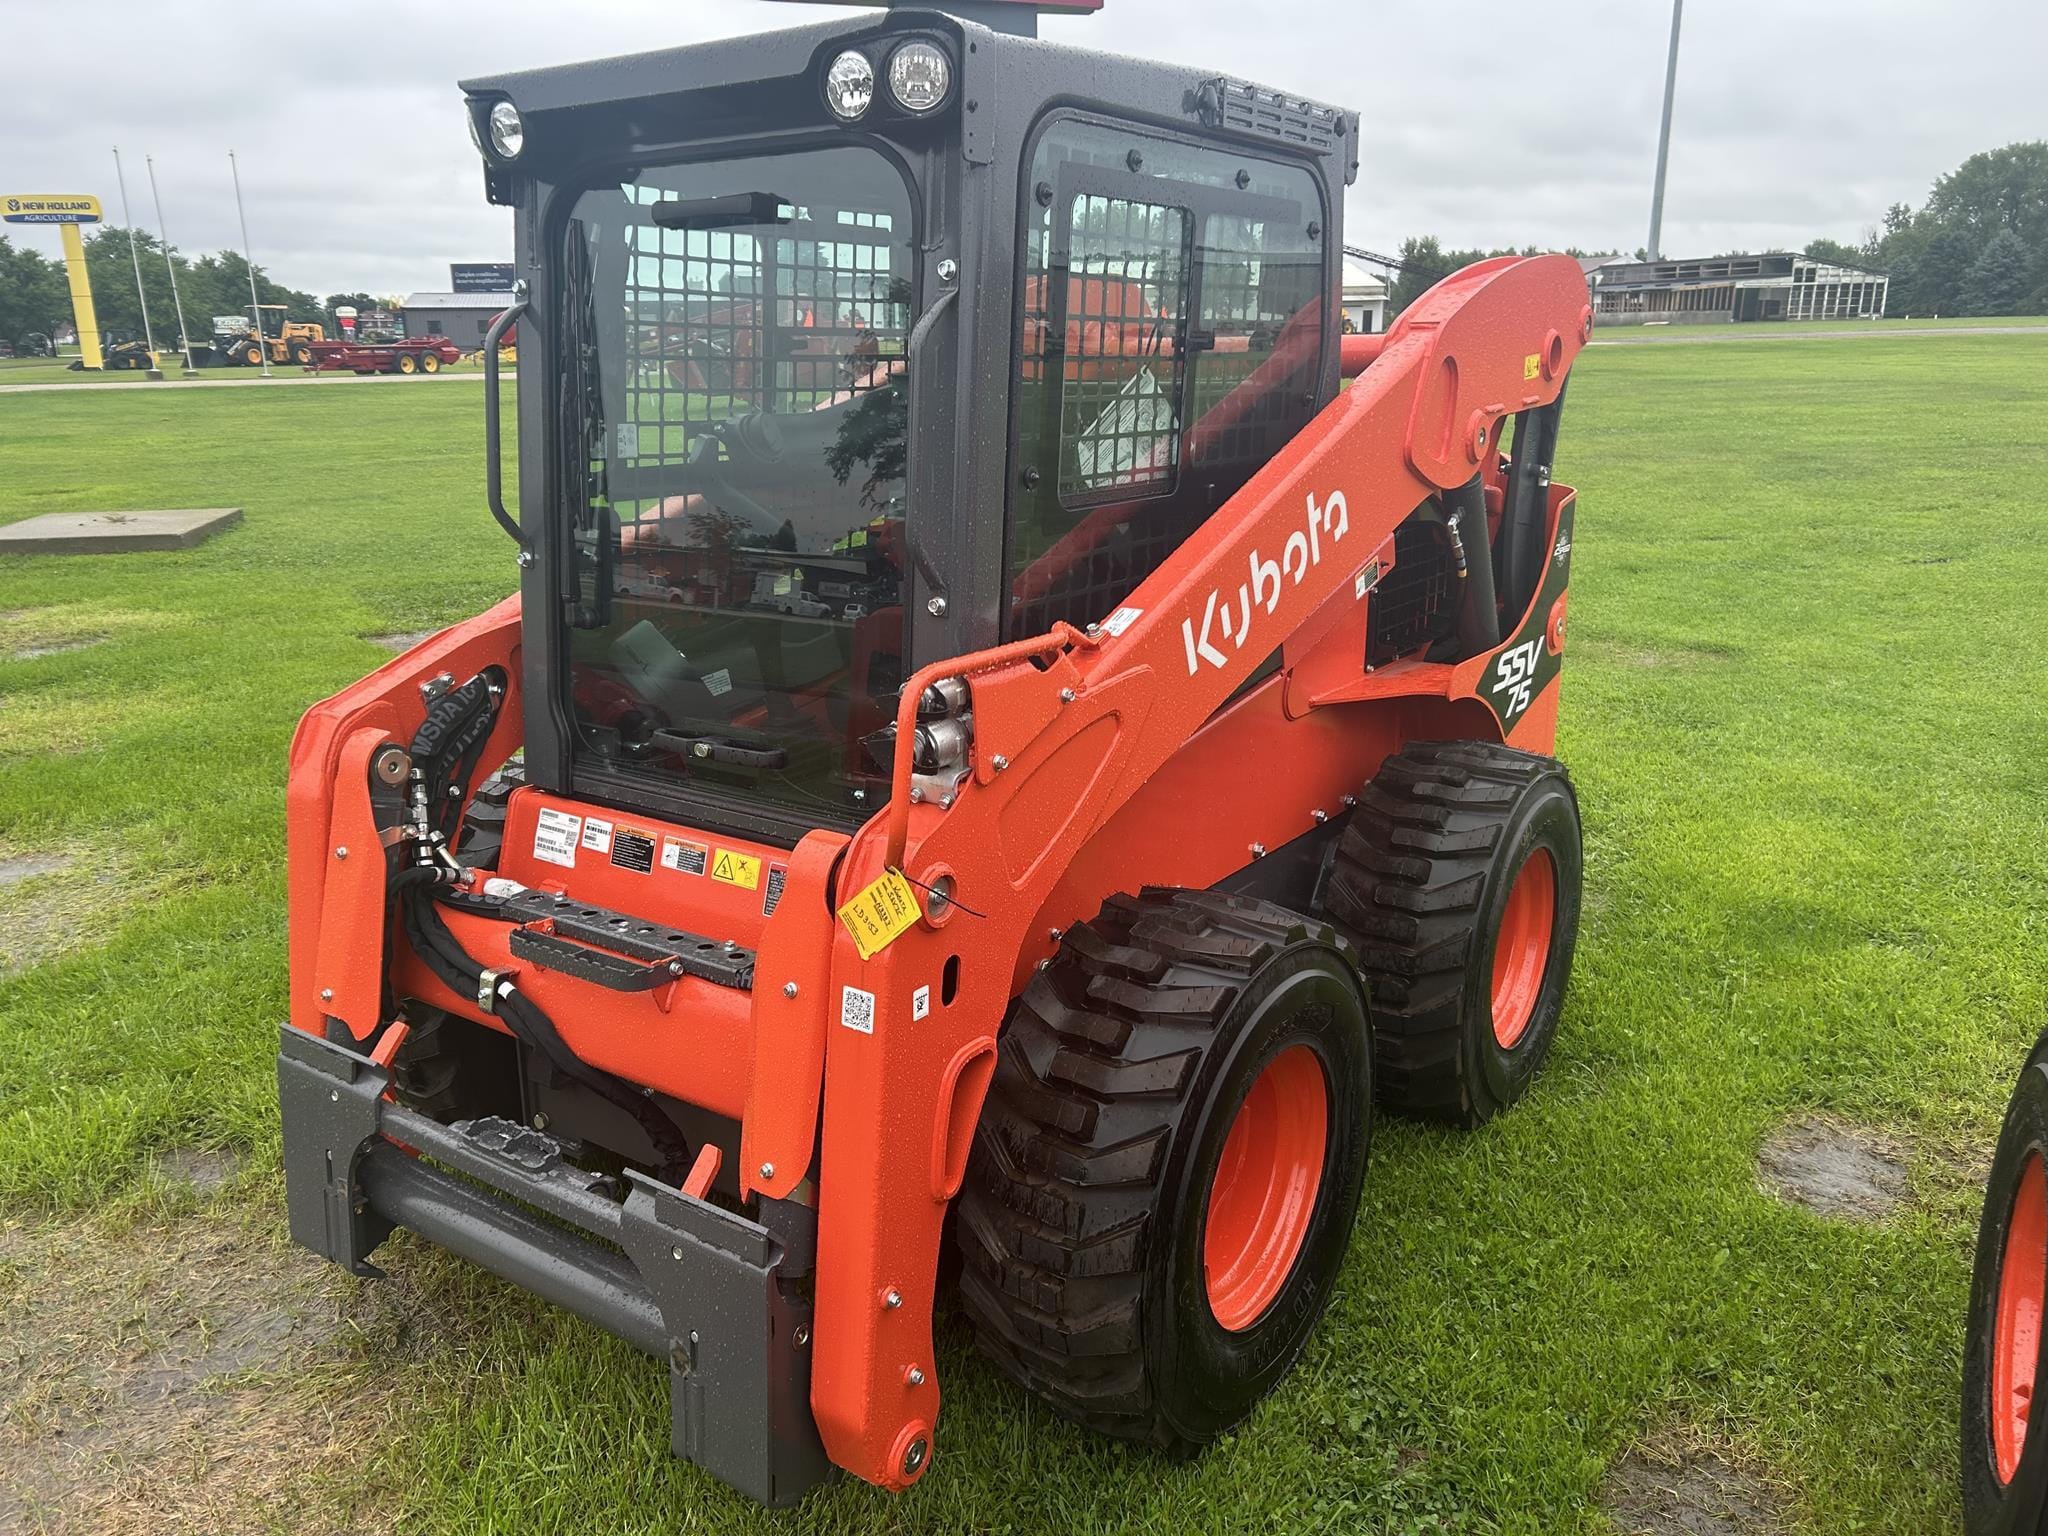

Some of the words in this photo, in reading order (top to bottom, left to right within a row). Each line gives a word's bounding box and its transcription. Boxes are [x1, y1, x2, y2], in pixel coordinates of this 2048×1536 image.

[22, 201, 45, 210] NEW
[46, 201, 91, 210] HOLLAND
[1181, 490, 1349, 677] Kubota
[1492, 634, 1546, 694] SSV
[1505, 678, 1533, 719] 75
[411, 701, 463, 756] MSHA
